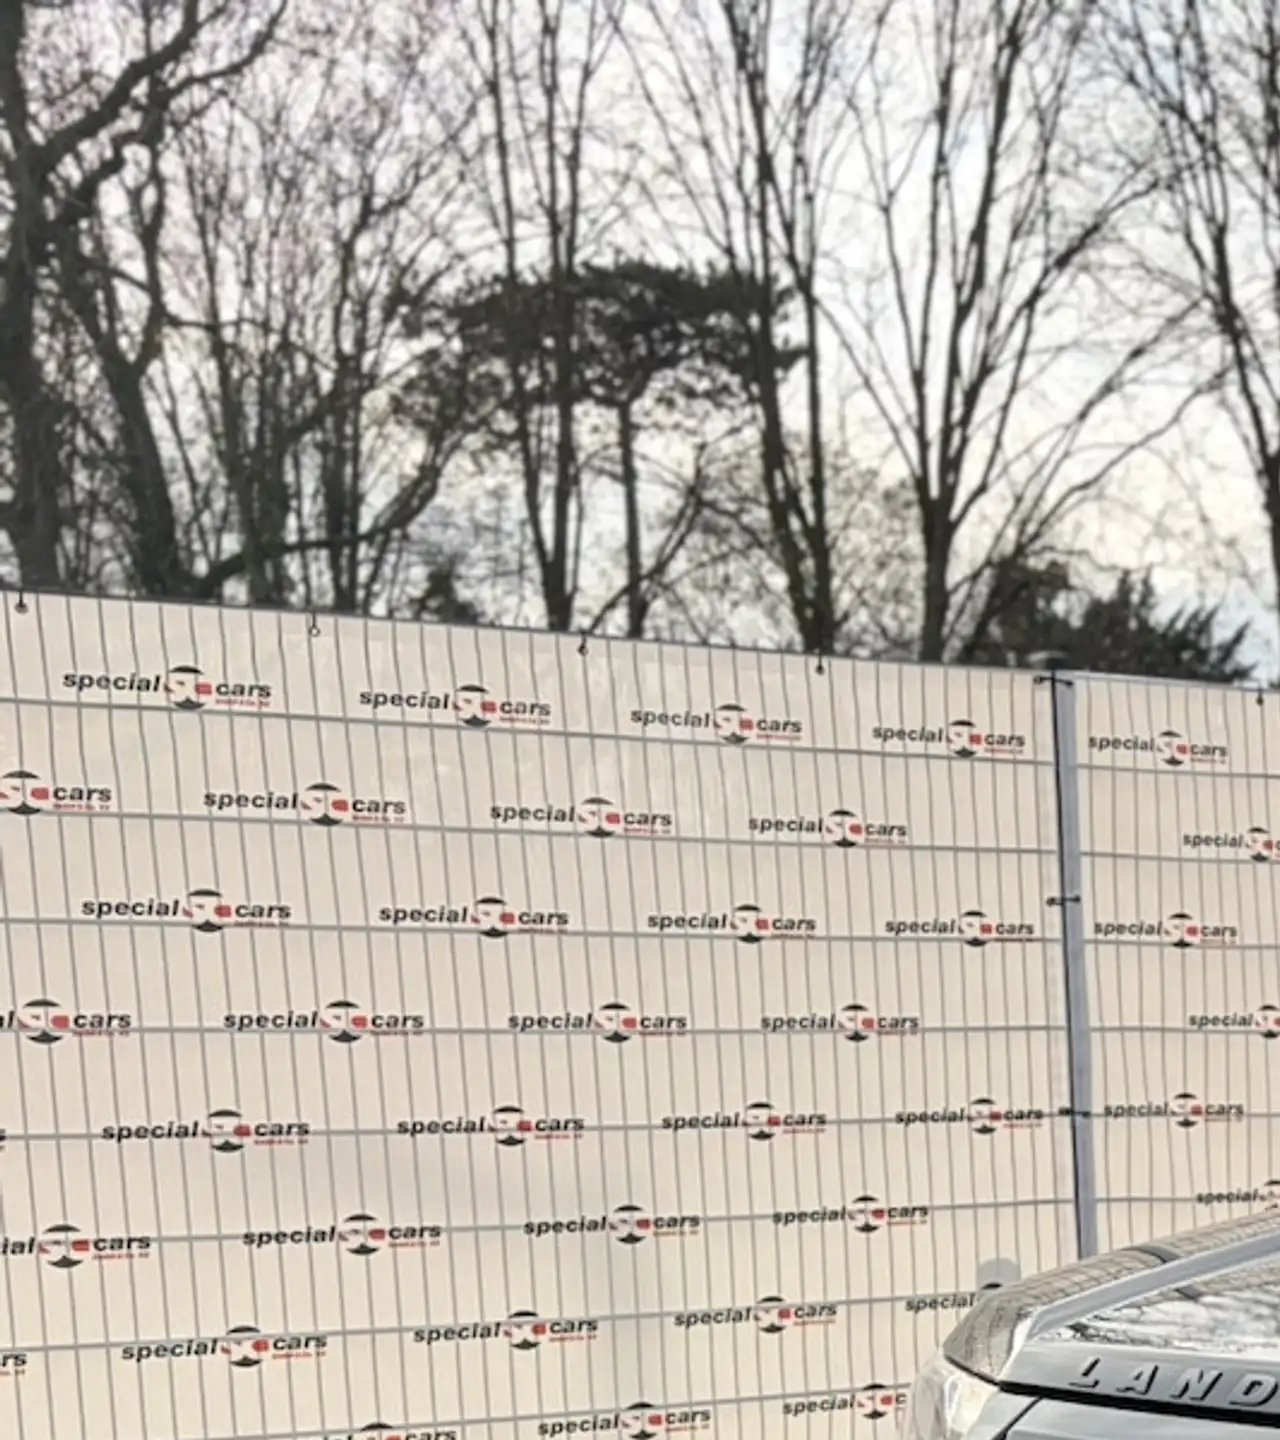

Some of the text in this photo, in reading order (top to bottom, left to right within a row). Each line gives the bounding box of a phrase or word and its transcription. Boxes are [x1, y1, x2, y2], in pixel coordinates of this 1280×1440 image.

[63, 673, 271, 698] special cars
[359, 691, 551, 717] special cars
[630, 710, 802, 733] special cars
[873, 725, 1026, 748] special cars
[1088, 736, 1227, 757] special cars
[53, 787, 111, 802] cars
[204, 791, 405, 814] special cars
[490, 805, 672, 827] special cars
[748, 817, 907, 837] special cars
[1183, 834, 1243, 848] special
[82, 899, 291, 919] special cars
[380, 906, 569, 925] special cars
[648, 913, 816, 932] special cars
[885, 918, 1034, 937] special cars
[1094, 920, 1237, 938] special cars
[73, 1014, 131, 1029] cars
[224, 1010, 424, 1033] special cars
[508, 1012, 687, 1033] special cars
[761, 1013, 919, 1033] special cars
[1189, 1013, 1254, 1032] special
[894, 1108, 1046, 1127] special cars
[1103, 1101, 1244, 1120] special cars
[101, 1120, 311, 1144] special cars
[396, 1116, 585, 1138] special cars
[661, 1113, 828, 1133] special cars
[523, 1215, 700, 1237] special cars
[771, 1205, 929, 1226] special cars
[93, 1236, 151, 1252] cars
[243, 1225, 441, 1249] special cars
[905, 1292, 976, 1315] special
[674, 1303, 837, 1330] special cars
[414, 1319, 598, 1346] special cars
[122, 1335, 327, 1364] special cars
[1068, 1355, 1279, 1408] LAND
[781, 1393, 856, 1417] special
[538, 1410, 711, 1438] special cars
